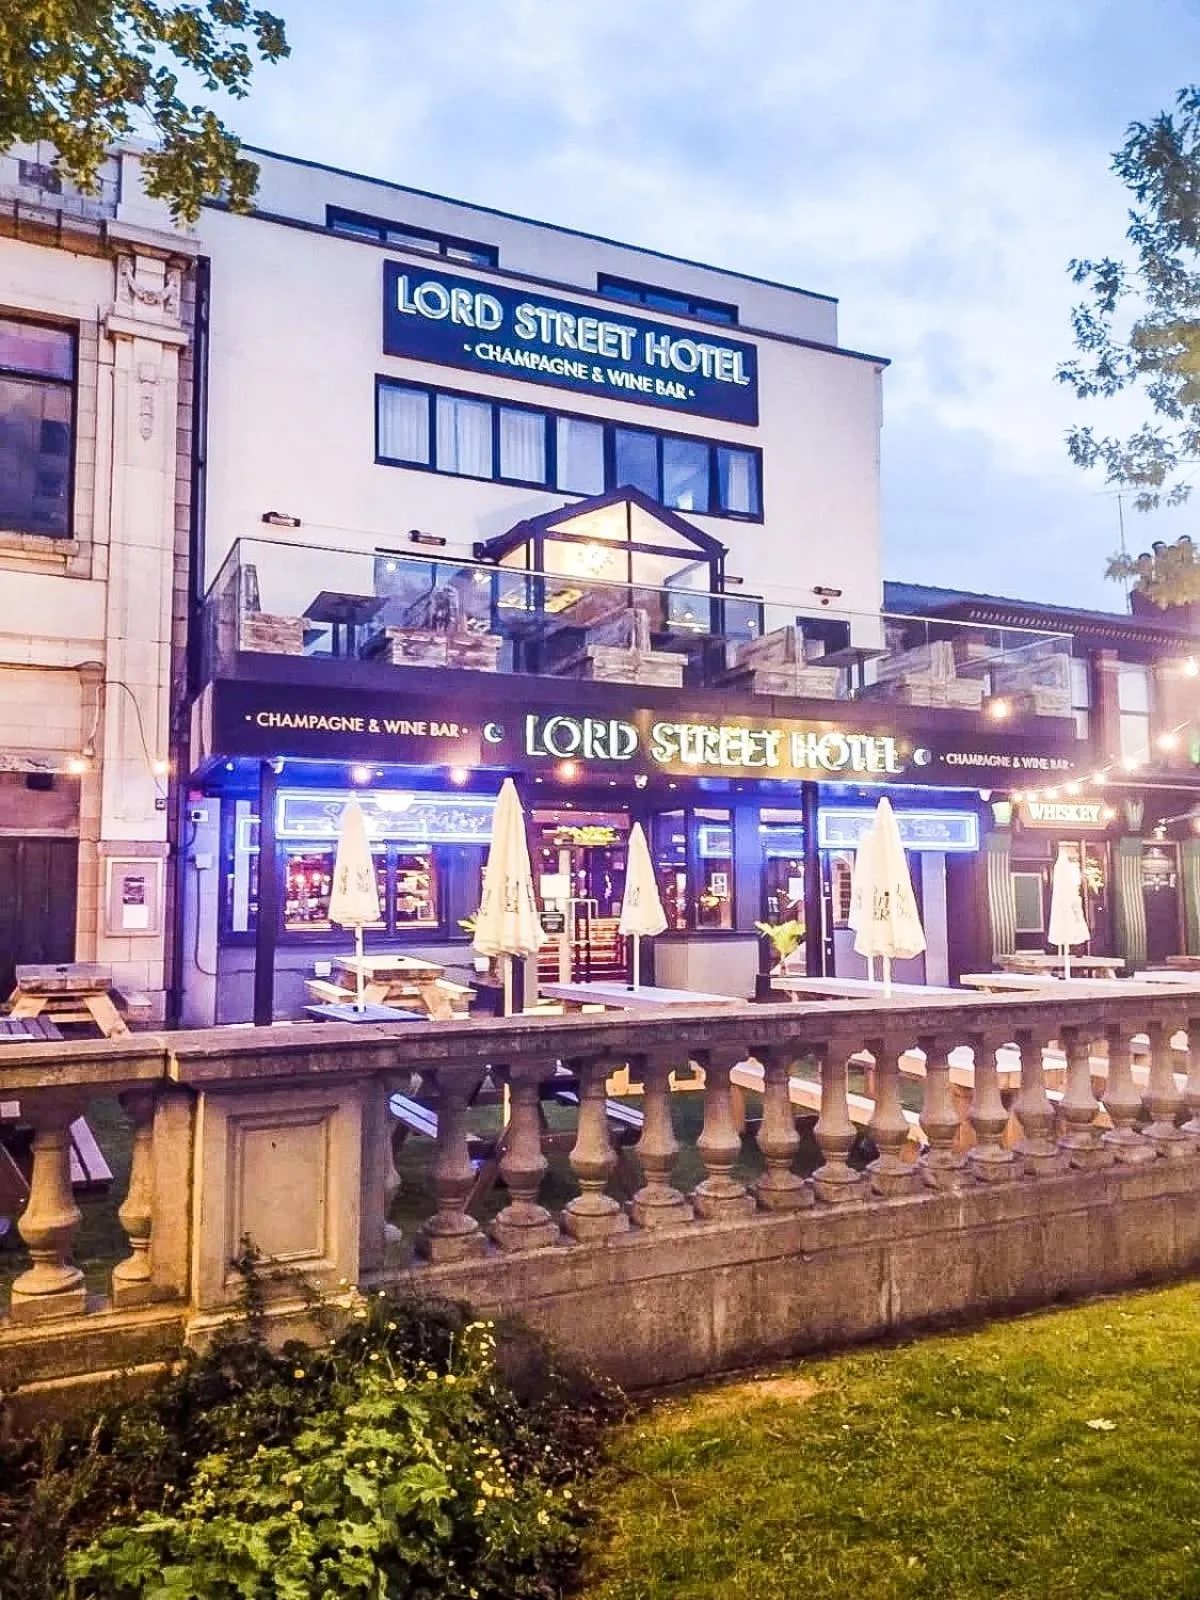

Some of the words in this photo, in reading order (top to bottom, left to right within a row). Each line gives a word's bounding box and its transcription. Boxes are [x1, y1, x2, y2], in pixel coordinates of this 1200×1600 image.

[397, 274, 504, 332] LORD
[513, 302, 637, 361] STREET
[645, 331, 750, 386] HOTEL
[475, 342, 589, 380] CHAMPAGNE
[592, 366, 605, 383] &
[607, 368, 653, 393] WINE
[655, 379, 687, 400] BAR
[256, 712, 365, 732] CHAMPAGNE
[368, 720, 380, 733] &
[383, 719, 427, 736] WINE
[430, 722, 460, 737] BAR
[525, 713, 639, 761] LORD
[651, 720, 786, 768] STREET
[790, 730, 904, 774] HOTEL
[946, 753, 1011, 768] CHAMPAGNE
[1012, 757, 1020, 768] &
[1021, 757, 1049, 769] WINE
[1050, 759, 1070, 770] BAR
[1028, 802, 1102, 822] WHISKEY
